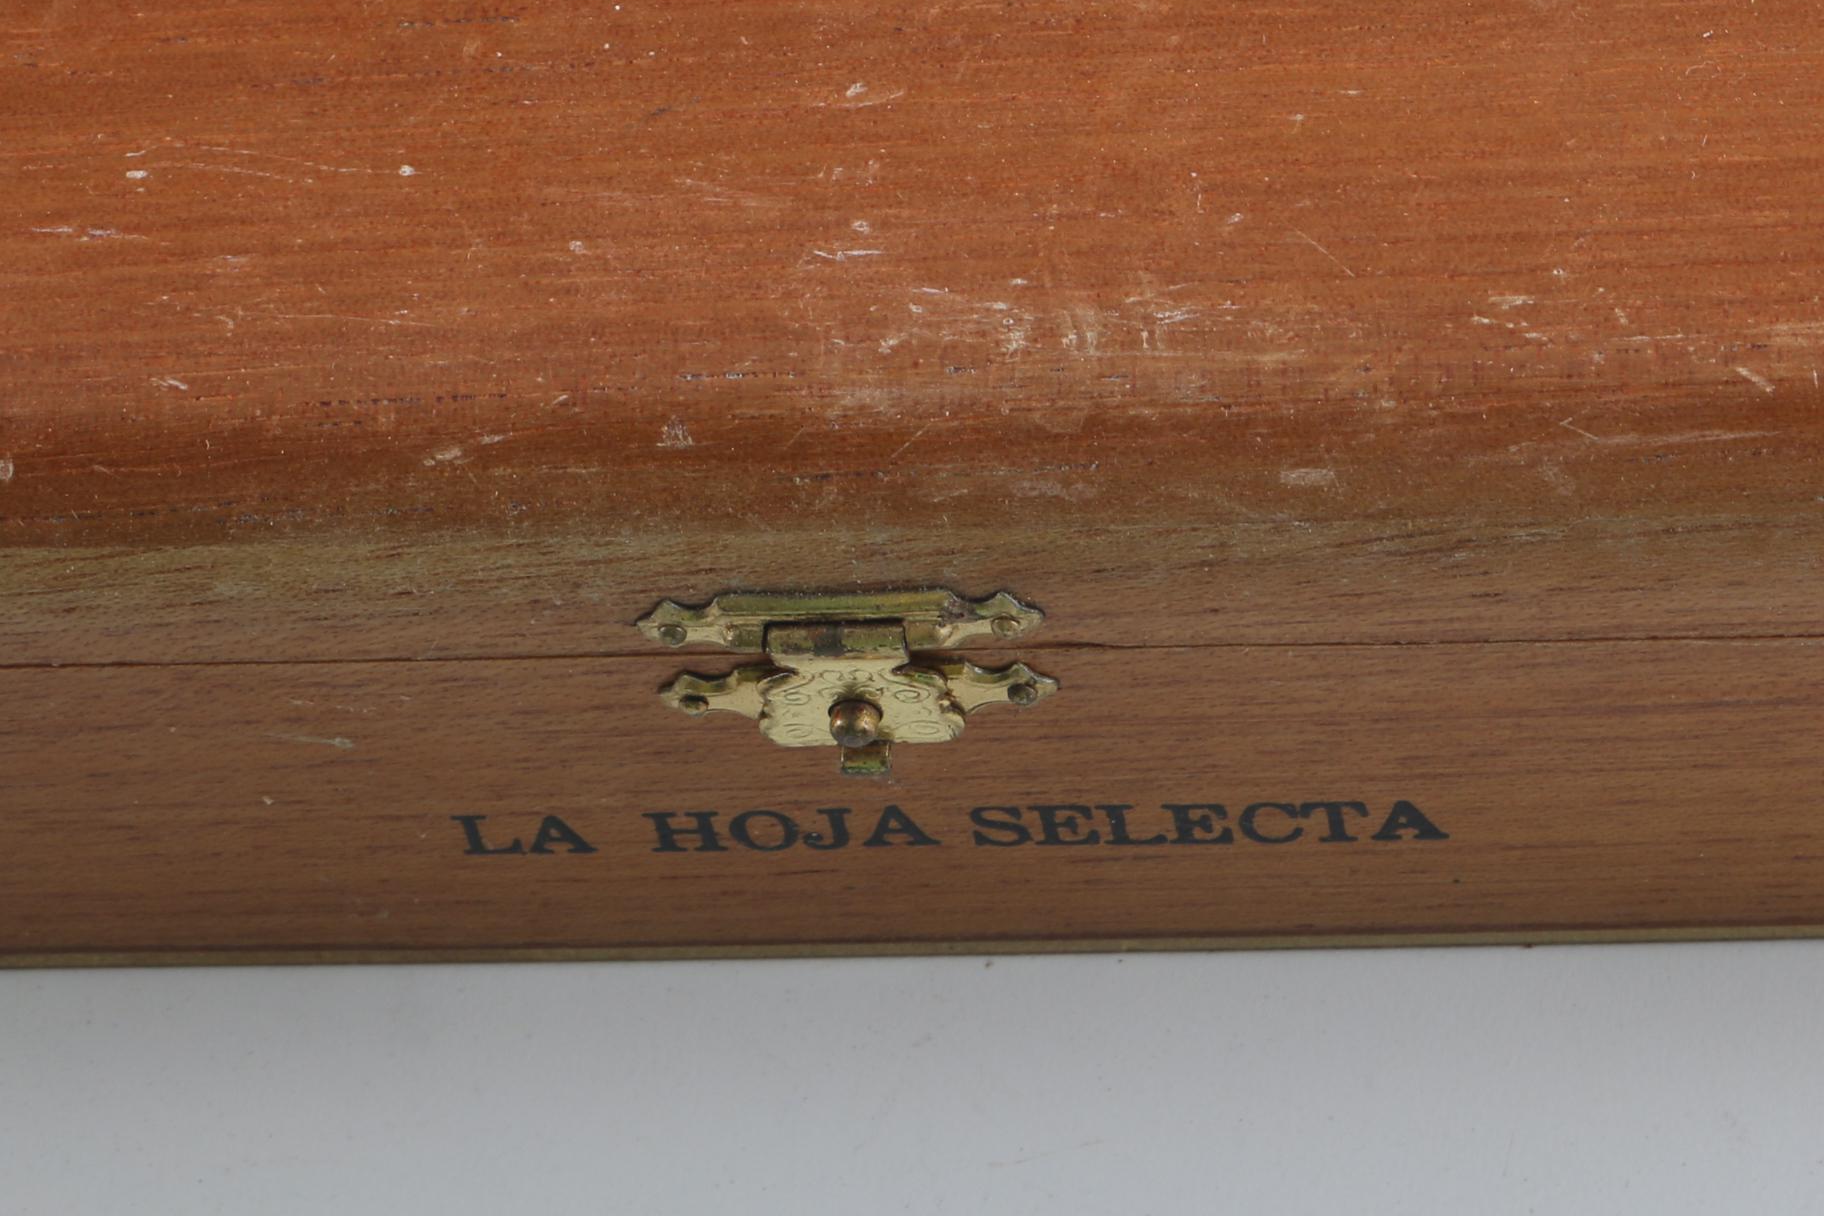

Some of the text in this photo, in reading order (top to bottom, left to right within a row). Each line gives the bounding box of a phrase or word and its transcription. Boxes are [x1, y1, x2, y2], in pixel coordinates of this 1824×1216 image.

[451, 799, 1449, 856] LA HOJA SELECTA
